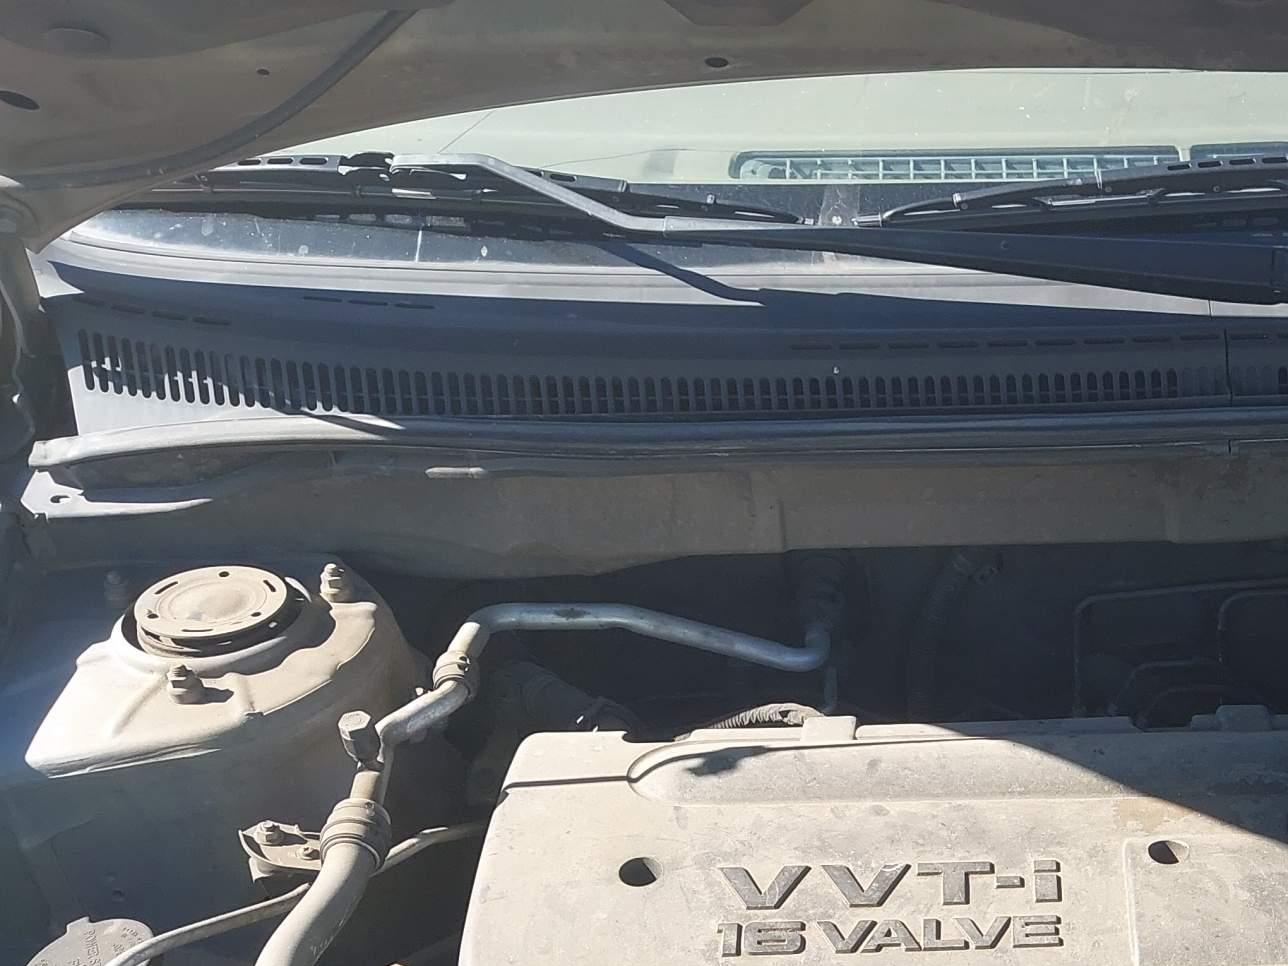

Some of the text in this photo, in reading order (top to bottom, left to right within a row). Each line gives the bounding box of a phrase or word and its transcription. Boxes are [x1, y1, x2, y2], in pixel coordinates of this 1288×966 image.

[717, 859, 1063, 911] VVT-i
[716, 915, 1065, 958] 16 VALVE
